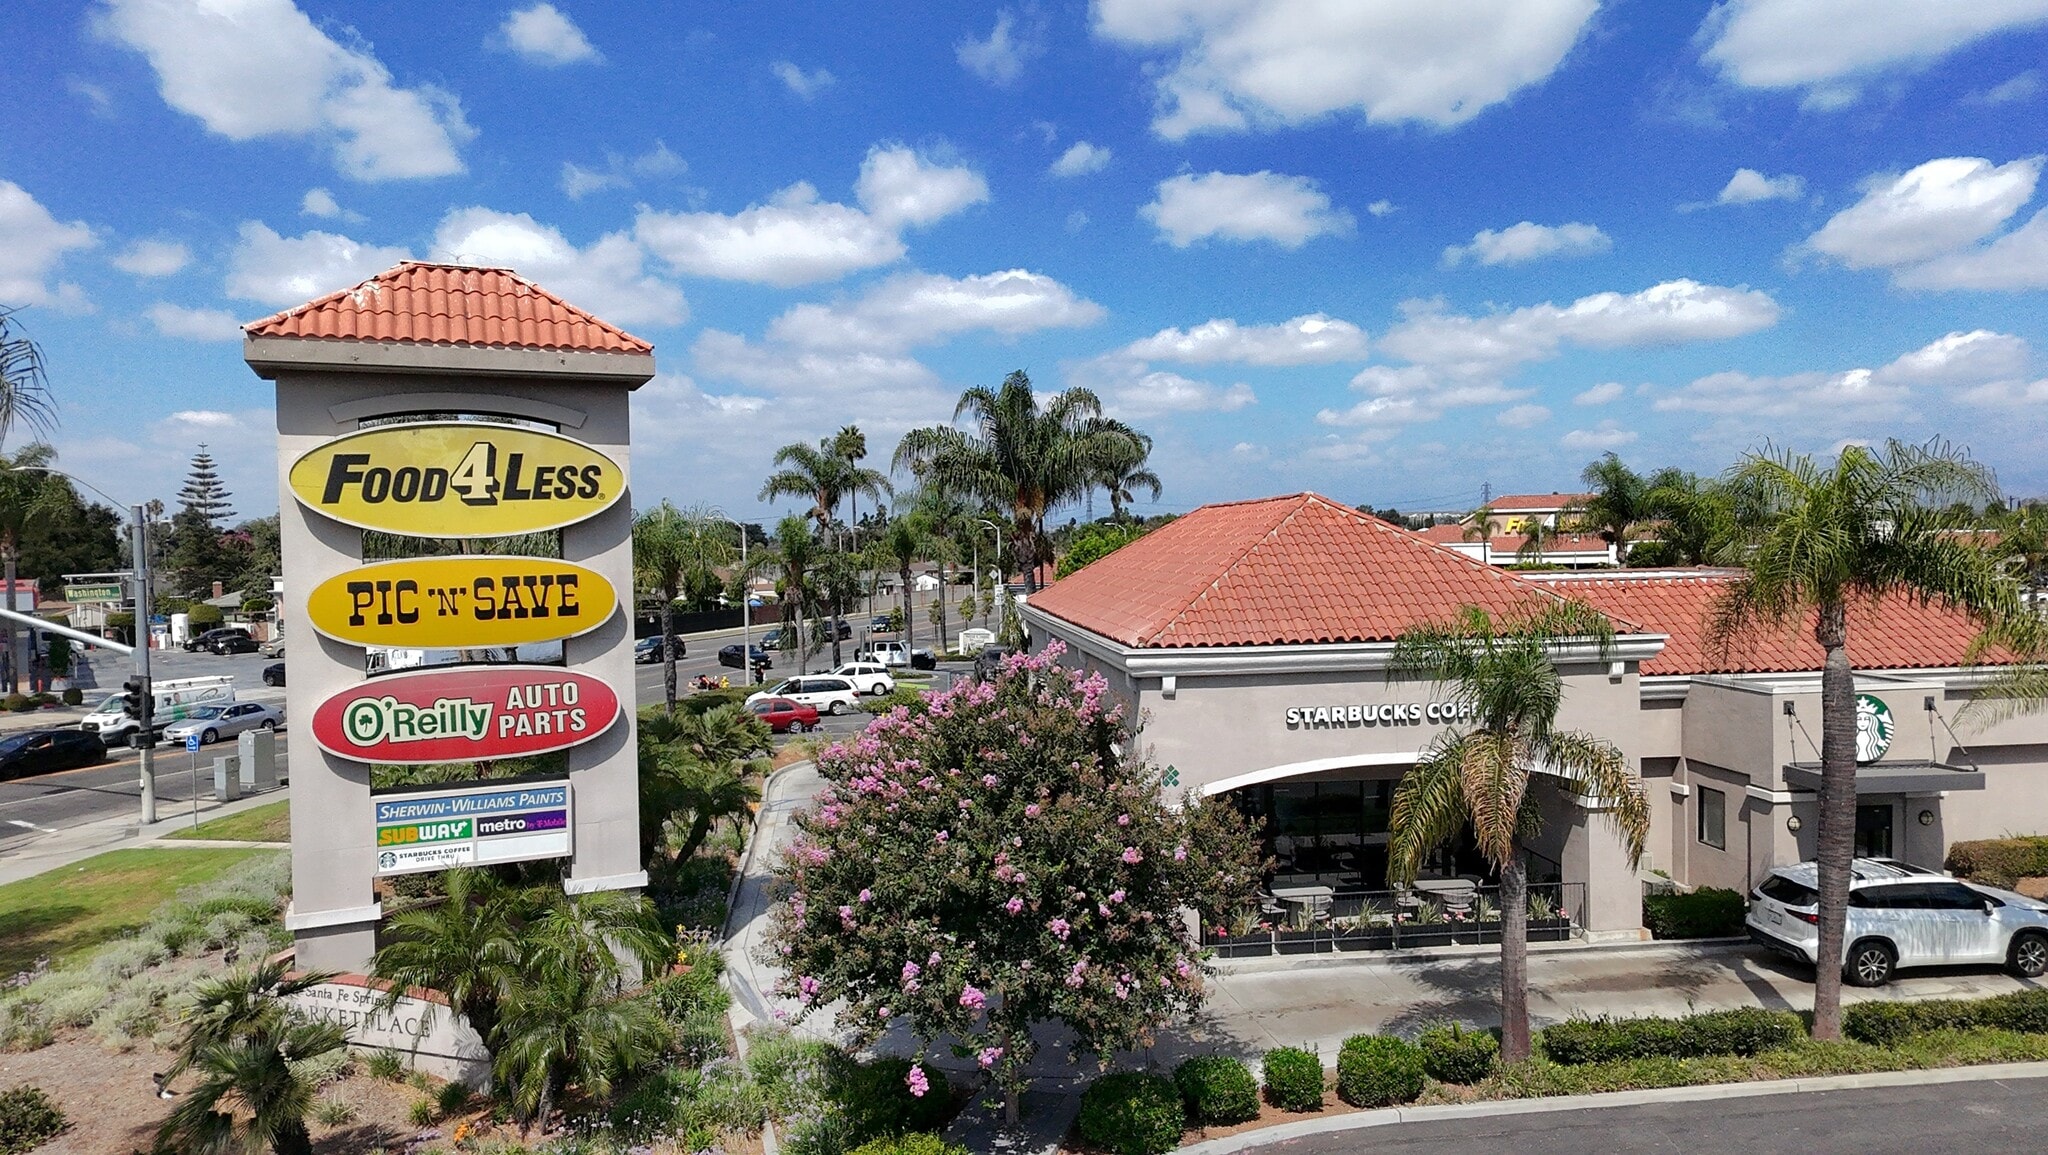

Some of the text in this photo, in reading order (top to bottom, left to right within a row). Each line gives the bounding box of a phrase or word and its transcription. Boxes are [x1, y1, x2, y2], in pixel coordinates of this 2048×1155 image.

[450, 442, 500, 506] 4
[67, 589, 111, 598] Washington
[347, 574, 579, 626] PIC 'N' SAVE
[506, 682, 578, 710] AUTO
[349, 701, 488, 742] O'Reilly
[499, 709, 586, 739] PARTS
[1286, 702, 1421, 724] STARBUCKS
[380, 791, 564, 820] SHERWIN-WILLIAMS PAINTS
[378, 821, 468, 846] SUBWAY
[479, 818, 526, 833] metro
[399, 846, 471, 859] STARBUCKS COFFEE
[416, 853, 455, 863] DRIVE THRU
[305, 988, 333, 999] Santa
[338, 988, 350, 1001] Fe
